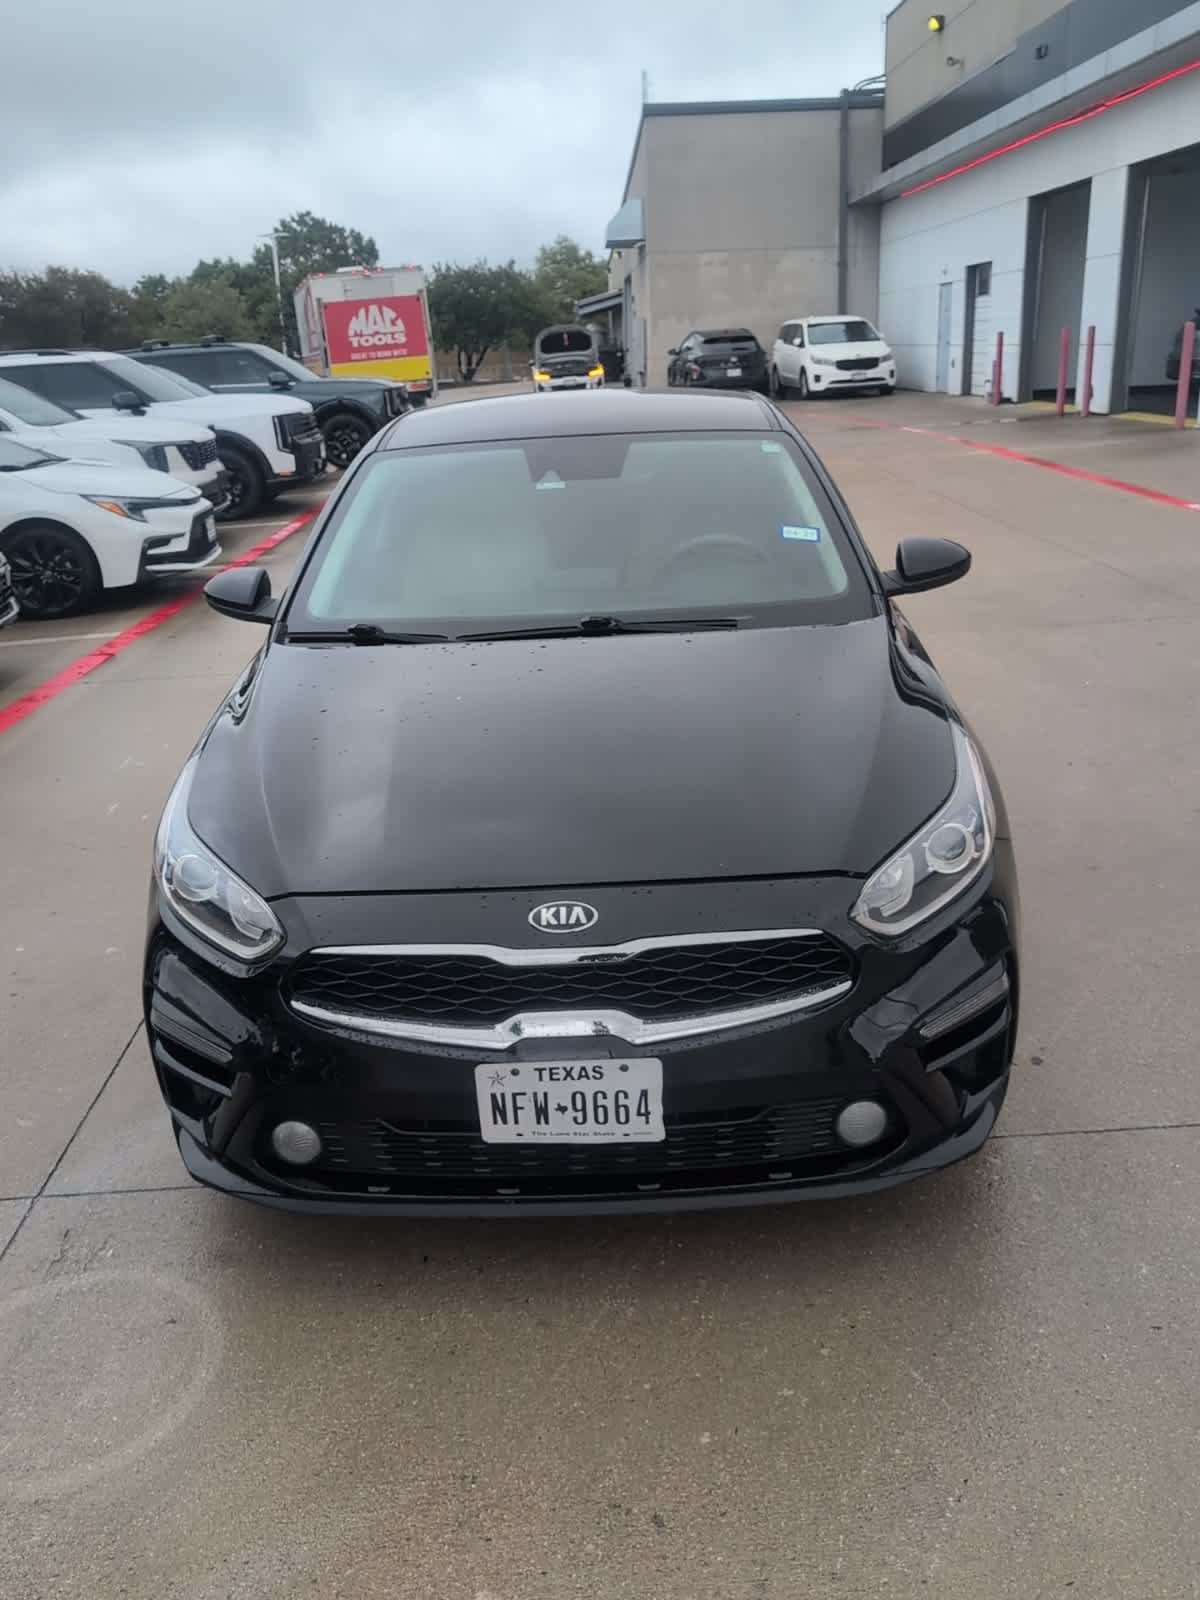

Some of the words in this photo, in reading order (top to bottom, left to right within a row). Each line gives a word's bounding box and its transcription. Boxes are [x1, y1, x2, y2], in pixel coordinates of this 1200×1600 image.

[348, 304, 406, 336] MAC
[348, 334, 407, 348] TOOLS
[540, 906, 588, 926] KIA
[534, 1065, 605, 1082] TEXAS
